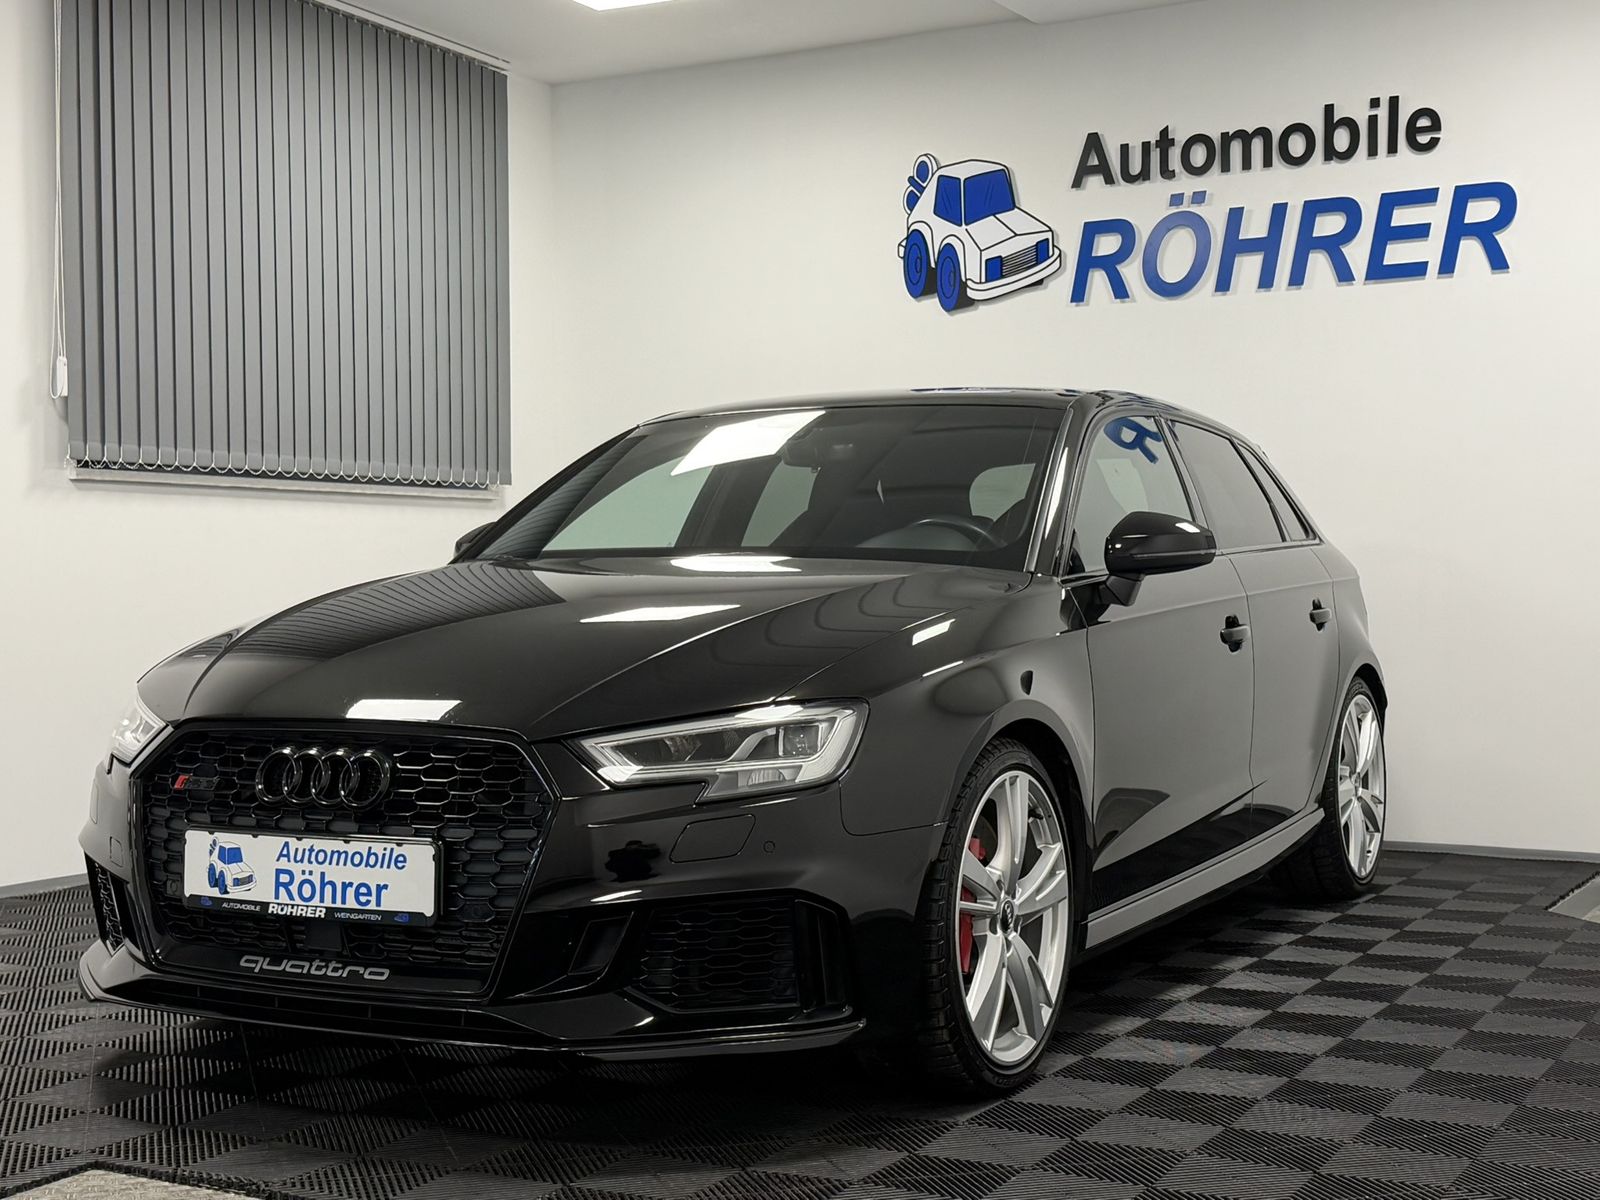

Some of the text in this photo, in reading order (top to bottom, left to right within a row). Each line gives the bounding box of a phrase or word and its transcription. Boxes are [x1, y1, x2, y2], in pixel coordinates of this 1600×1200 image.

[1071, 95, 1442, 189] Automobile
[1069, 181, 1518, 304] RÖHRER
[276, 840, 408, 870] Automobile
[274, 868, 389, 907] Röhrer
[222, 902, 382, 921] AUTOMOBILE RÖHRER WEINGARTEN
[239, 954, 390, 981] quattro
